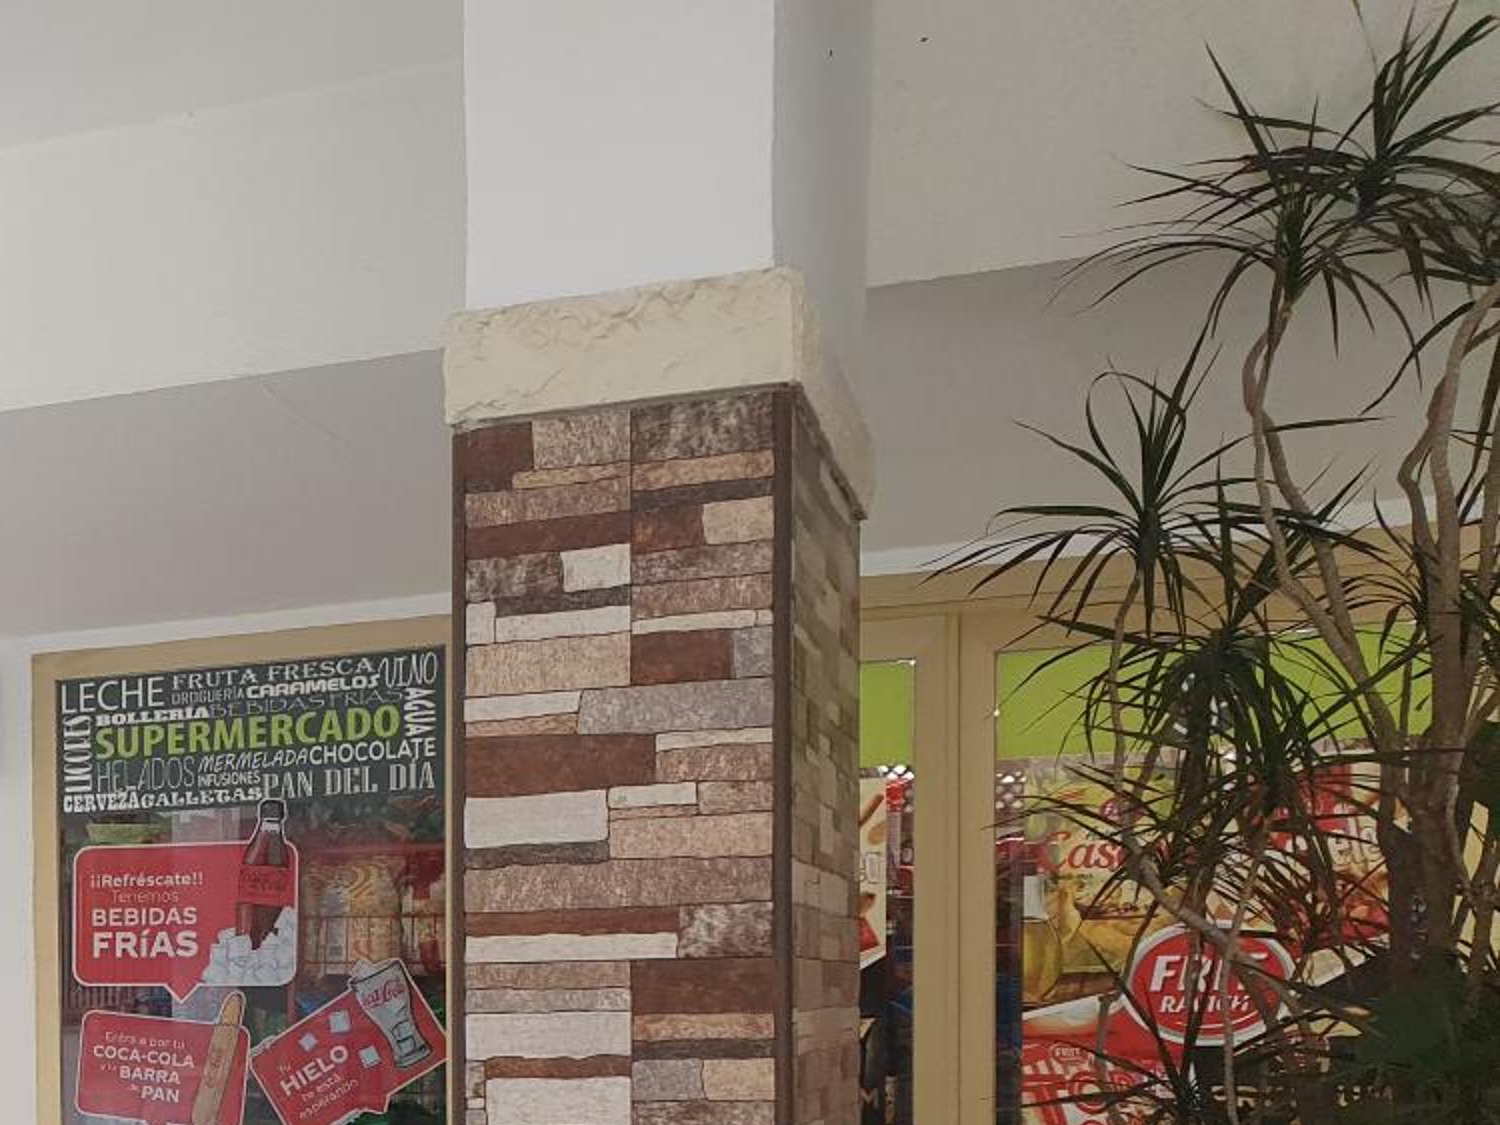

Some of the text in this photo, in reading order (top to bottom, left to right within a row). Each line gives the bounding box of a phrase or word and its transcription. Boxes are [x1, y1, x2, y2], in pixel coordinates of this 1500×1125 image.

[172, 657, 376, 690] FRUTA FRESCA
[377, 651, 438, 688] VINO
[61, 676, 165, 714] LECHE
[246, 673, 380, 699] CARAMELOS
[403, 687, 437, 737] AGUA
[95, 704, 400, 760] SUPERMERCADO
[62, 714, 94, 794] LICORES
[197, 747, 308, 774] MERMELADA
[308, 737, 437, 766] CHOCOLATE
[97, 755, 196, 794] HELADOS
[197, 769, 261, 788] INFUSIONES
[261, 759, 436, 800] PAN DEL DÍA
[63, 790, 141, 813] CERVEZA
[140, 786, 263, 809] GALLETAS
[111, 889, 179, 903] Tenemos
[91, 906, 198, 927] BEBIDAS
[92, 1044, 196, 1069] COCA-COLA
[119, 1065, 181, 1085] BARRA
[280, 1044, 349, 1098] HIELO
[141, 1085, 180, 1103] PAN
